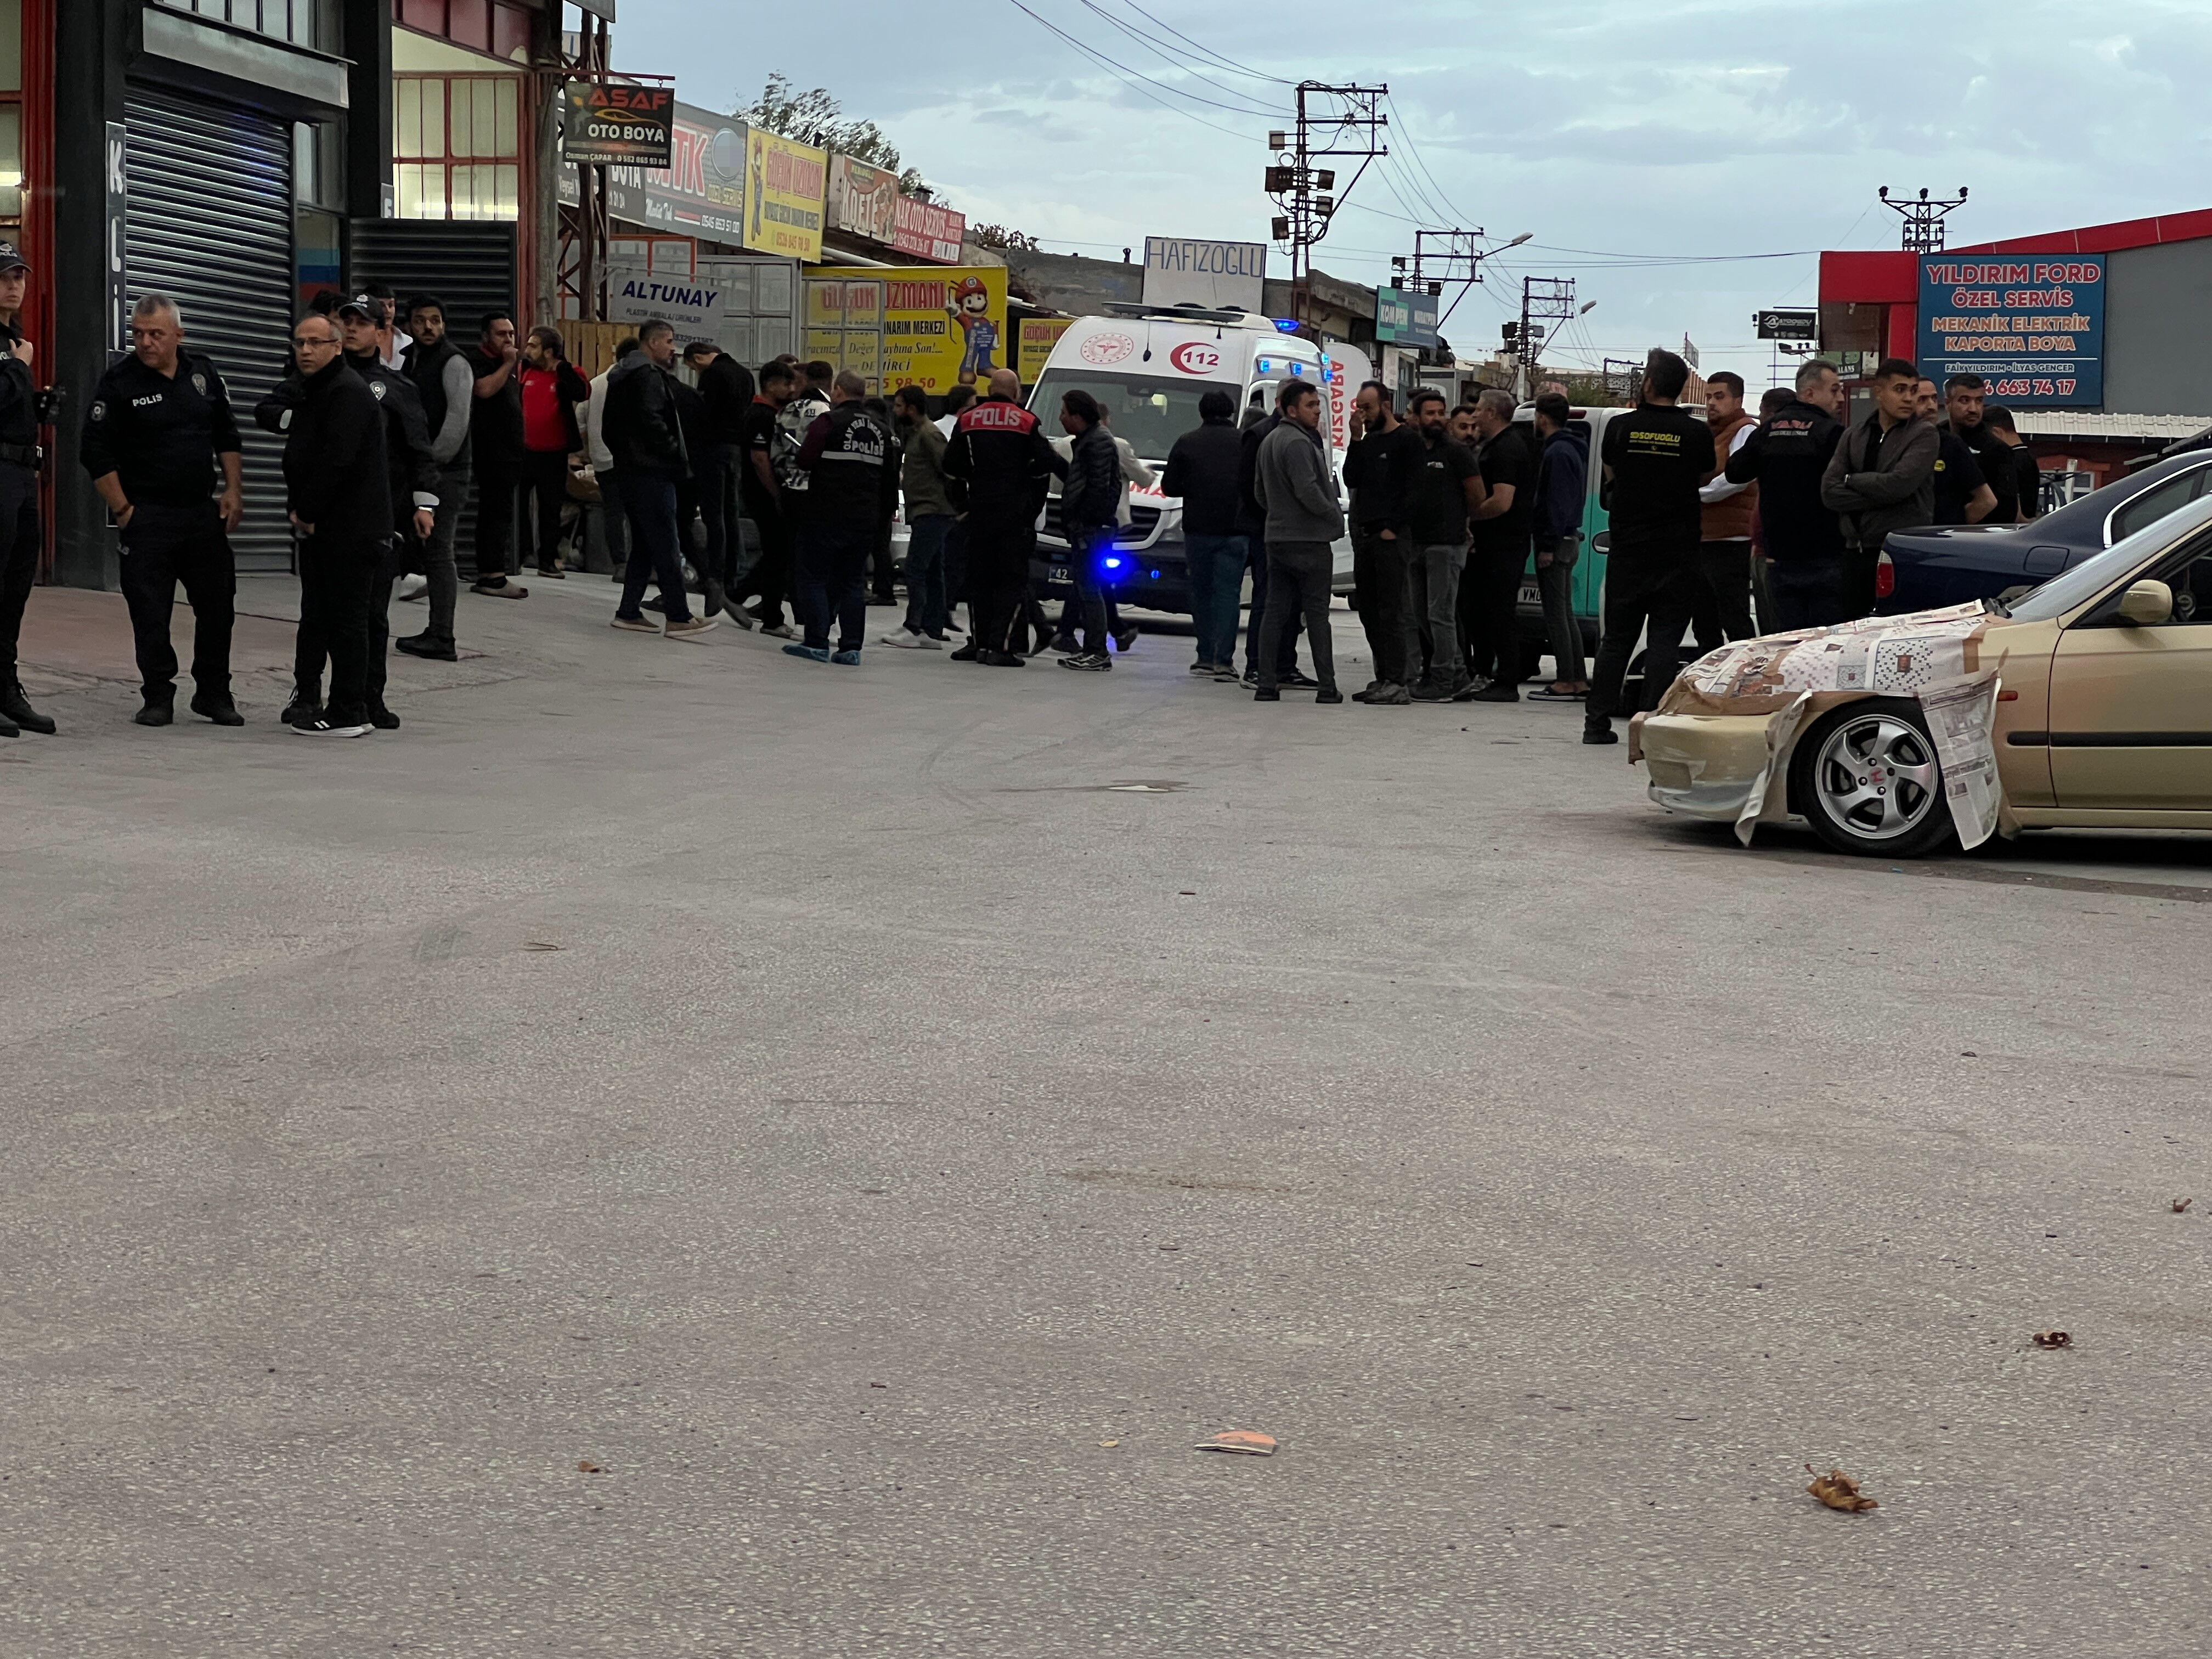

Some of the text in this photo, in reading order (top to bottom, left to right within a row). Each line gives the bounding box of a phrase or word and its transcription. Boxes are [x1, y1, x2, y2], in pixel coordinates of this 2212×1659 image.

[588, 88, 669, 110] ASAF
[588, 123, 665, 143] OTO BOYA
[1926, 263, 2101, 284] YILDIRIM FORD
[622, 280, 718, 308] ALTUNAY
[1951, 286, 2074, 308] ÖZEL SERVİS
[913, 317, 945, 335] MERKEZİ
[1932, 312, 2091, 332] MEKANİK ELEKTRİK
[884, 342, 912, 357] aybına
[1945, 335, 2076, 352] KAPORTA BOYA
[1183, 351, 1220, 366] 112
[1945, 362, 2075, 373] FAİK YILDIRIM İLYAS GENCER
[919, 377, 936, 388] 50
[1996, 379, 2030, 396] 663
[2033, 379, 2054, 396] 74
[2056, 379, 2076, 396] 17
[1056, 568, 1068, 579] 42
